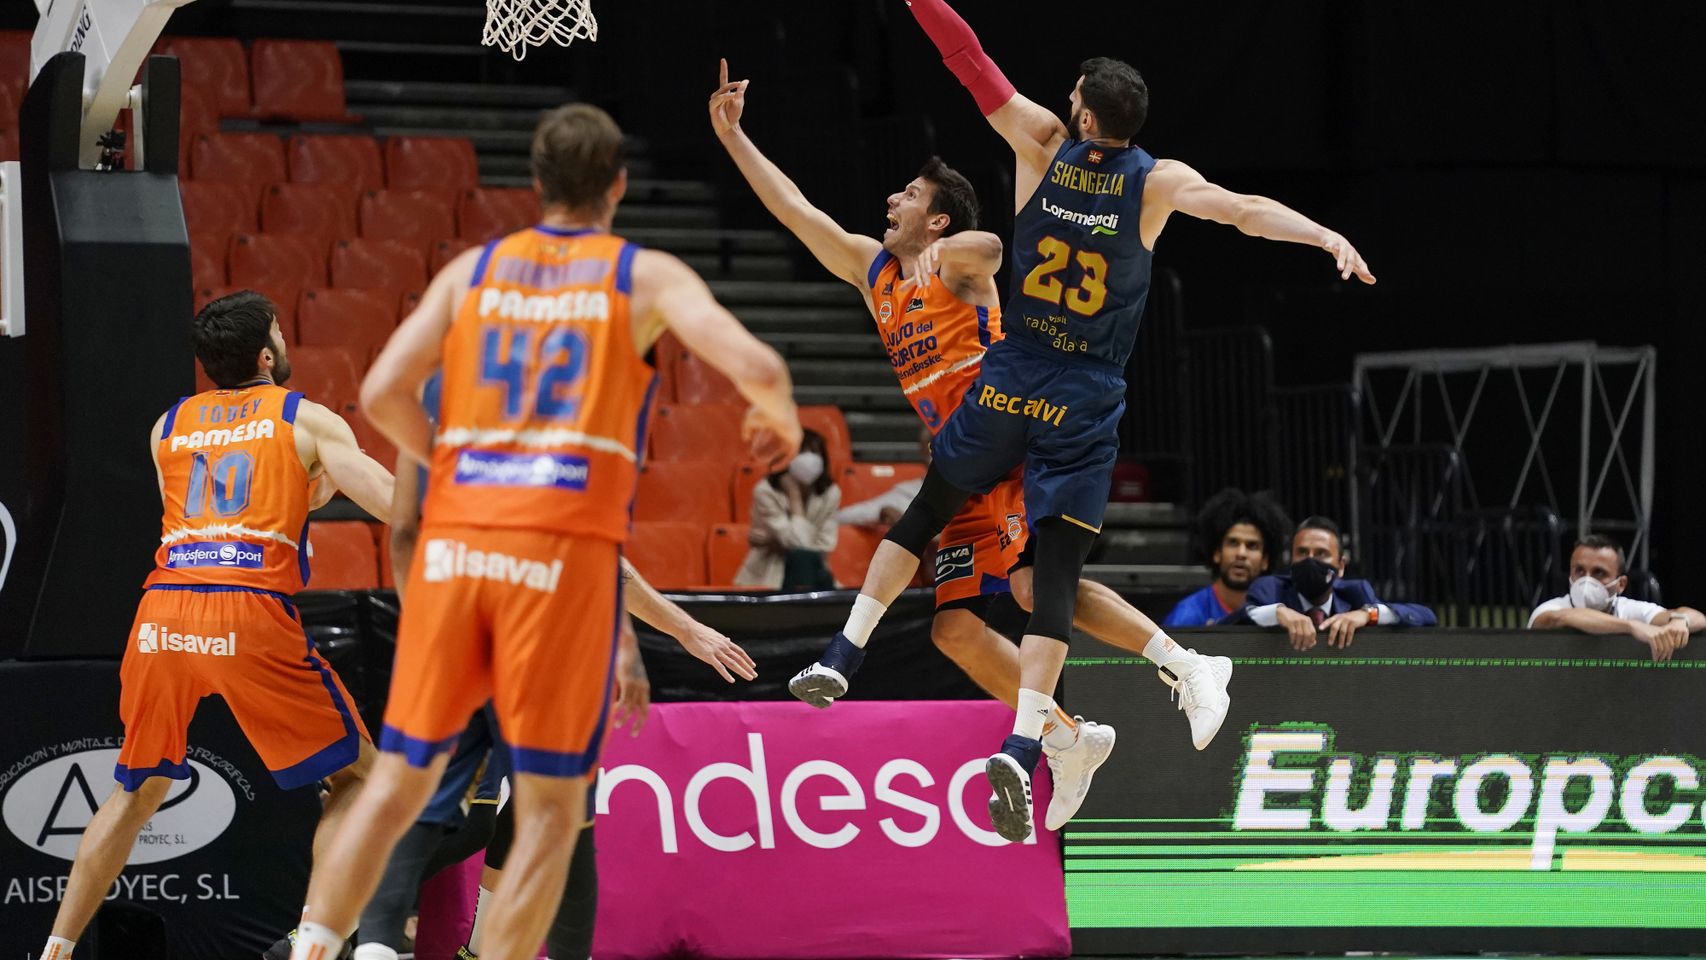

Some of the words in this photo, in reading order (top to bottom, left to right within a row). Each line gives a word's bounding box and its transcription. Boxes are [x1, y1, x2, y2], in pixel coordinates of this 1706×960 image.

[1051, 160, 1125, 197] SHENGELIA
[1042, 198, 1119, 229] Loramendi
[1022, 235, 1108, 317] 23
[479, 287, 608, 322] PAMESA
[916, 321, 933, 334] del
[1023, 314, 1057, 336] raba
[479, 324, 592, 421] 42
[199, 398, 261, 423] TOBEY
[978, 384, 1068, 427] Recalvi
[171, 418, 274, 452] PAMESA
[183, 449, 253, 519] 10
[168, 549, 218, 565] Atmósfera
[219, 544, 262, 565] Sport
[456, 541, 563, 593] isaval
[161, 627, 236, 656] isaval
[595, 732, 1037, 854] ndesa
[1232, 730, 1706, 871] Europc
[4, 873, 188, 905] AISPOYEC,
[197, 873, 240, 900] S.L
